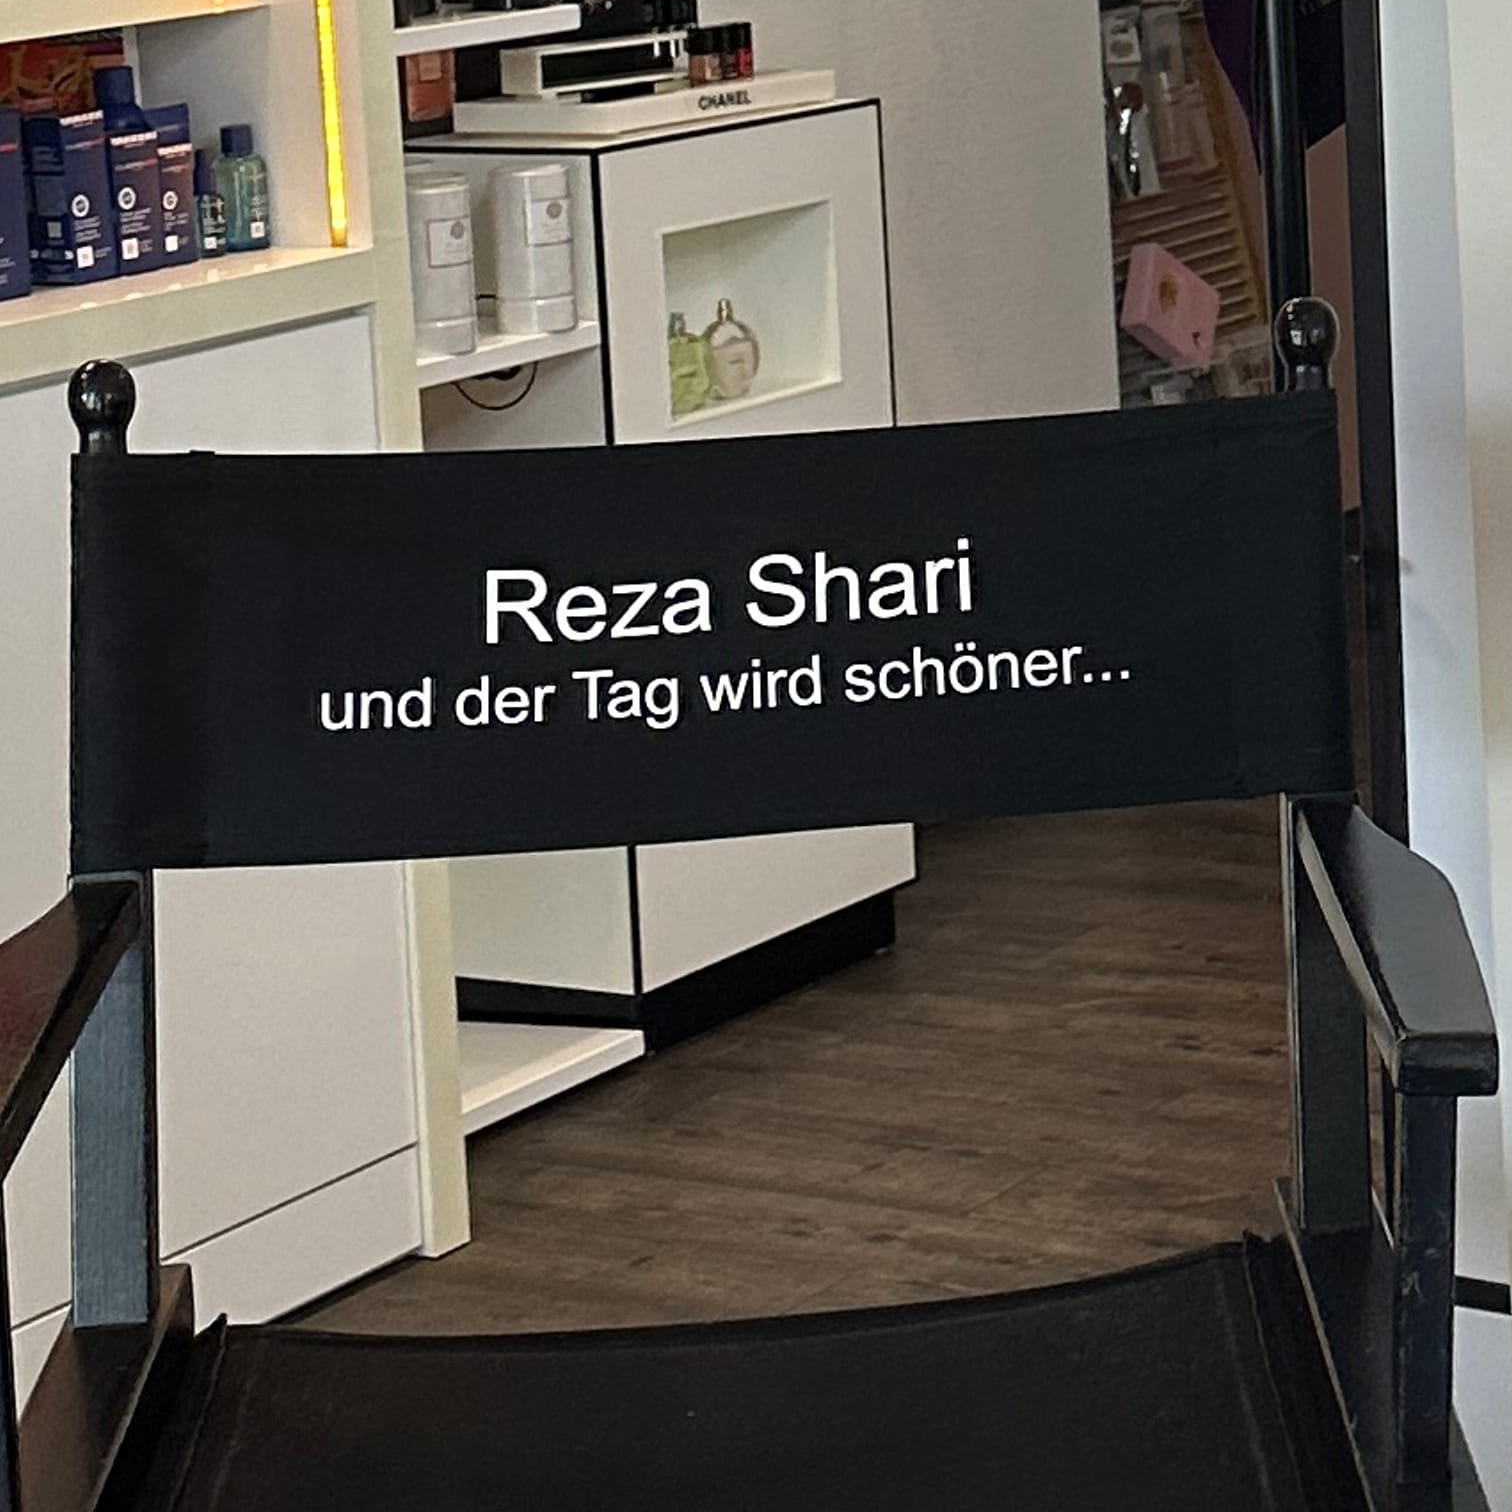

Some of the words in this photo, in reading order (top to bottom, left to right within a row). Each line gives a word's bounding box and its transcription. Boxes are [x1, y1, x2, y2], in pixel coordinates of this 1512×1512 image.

[698, 90, 752, 110] CHANEL
[485, 569, 712, 645] Reza
[745, 537, 972, 627] Shari
[320, 676, 433, 731] und
[455, 675, 556, 727] der
[571, 669, 679, 730] Tag
[700, 654, 822, 712] wird
[844, 641, 1131, 703] schöner...
